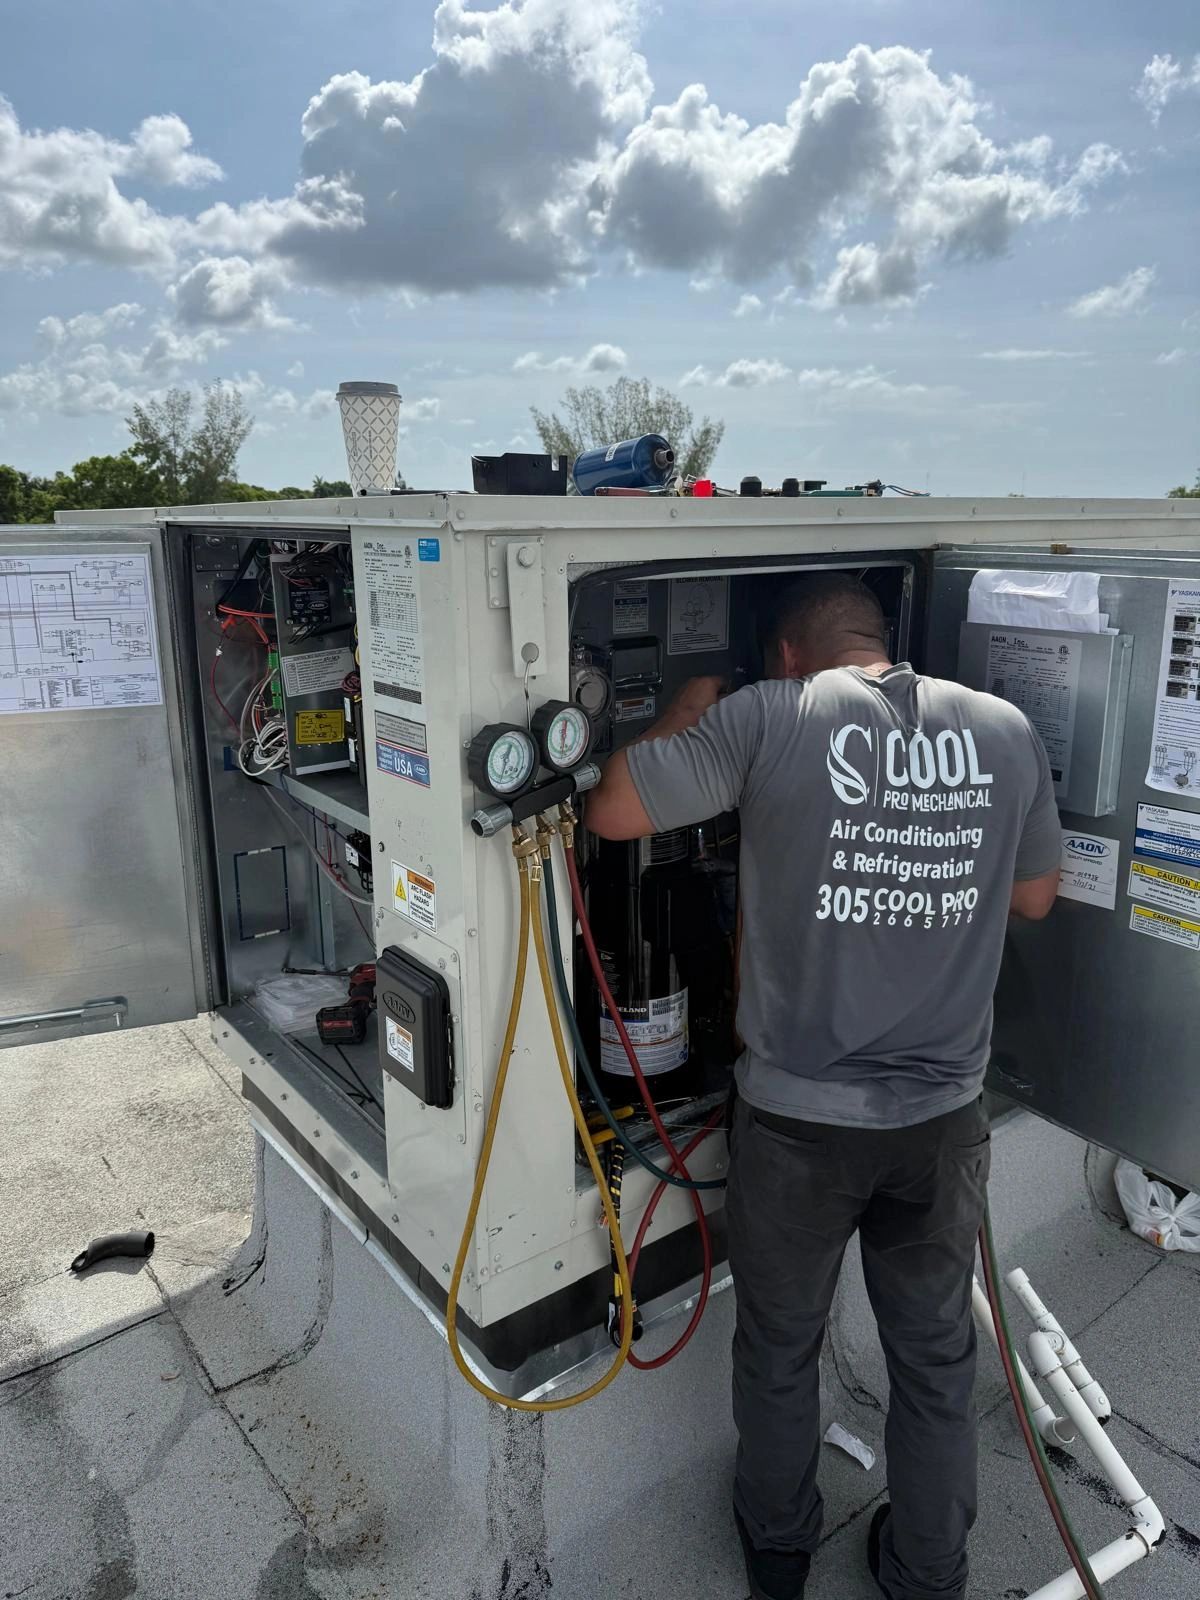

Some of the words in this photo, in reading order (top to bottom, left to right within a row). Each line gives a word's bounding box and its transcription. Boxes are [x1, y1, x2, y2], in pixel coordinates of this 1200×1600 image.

[394, 757, 413, 777] USA
[886, 728, 993, 789] COOL
[883, 790, 908, 810] PRO
[912, 789, 992, 812] MECHANICAL
[830, 819, 860, 840] Air
[864, 822, 983, 849] Conditioning
[1066, 840, 1104, 855] AAON
[832, 850, 848, 871] &
[853, 852, 974, 883] Refrigeration
[1157, 871, 1190, 886] CAUTION
[414, 894, 430, 907] HAZARD
[816, 884, 870, 923] 305
[874, 888, 936, 916] COOL
[942, 887, 978, 916] PRO
[873, 912, 880, 926] 2
[887, 912, 896, 926] 6
[904, 914, 913, 928] 6
[924, 916, 933, 929] 5
[942, 914, 950, 928] 7
[954, 912, 961, 926] 7
[966, 911, 973, 924] 6
[1152, 914, 1181, 925] CAUTION
[600, 1002, 647, 1013] CELAND
